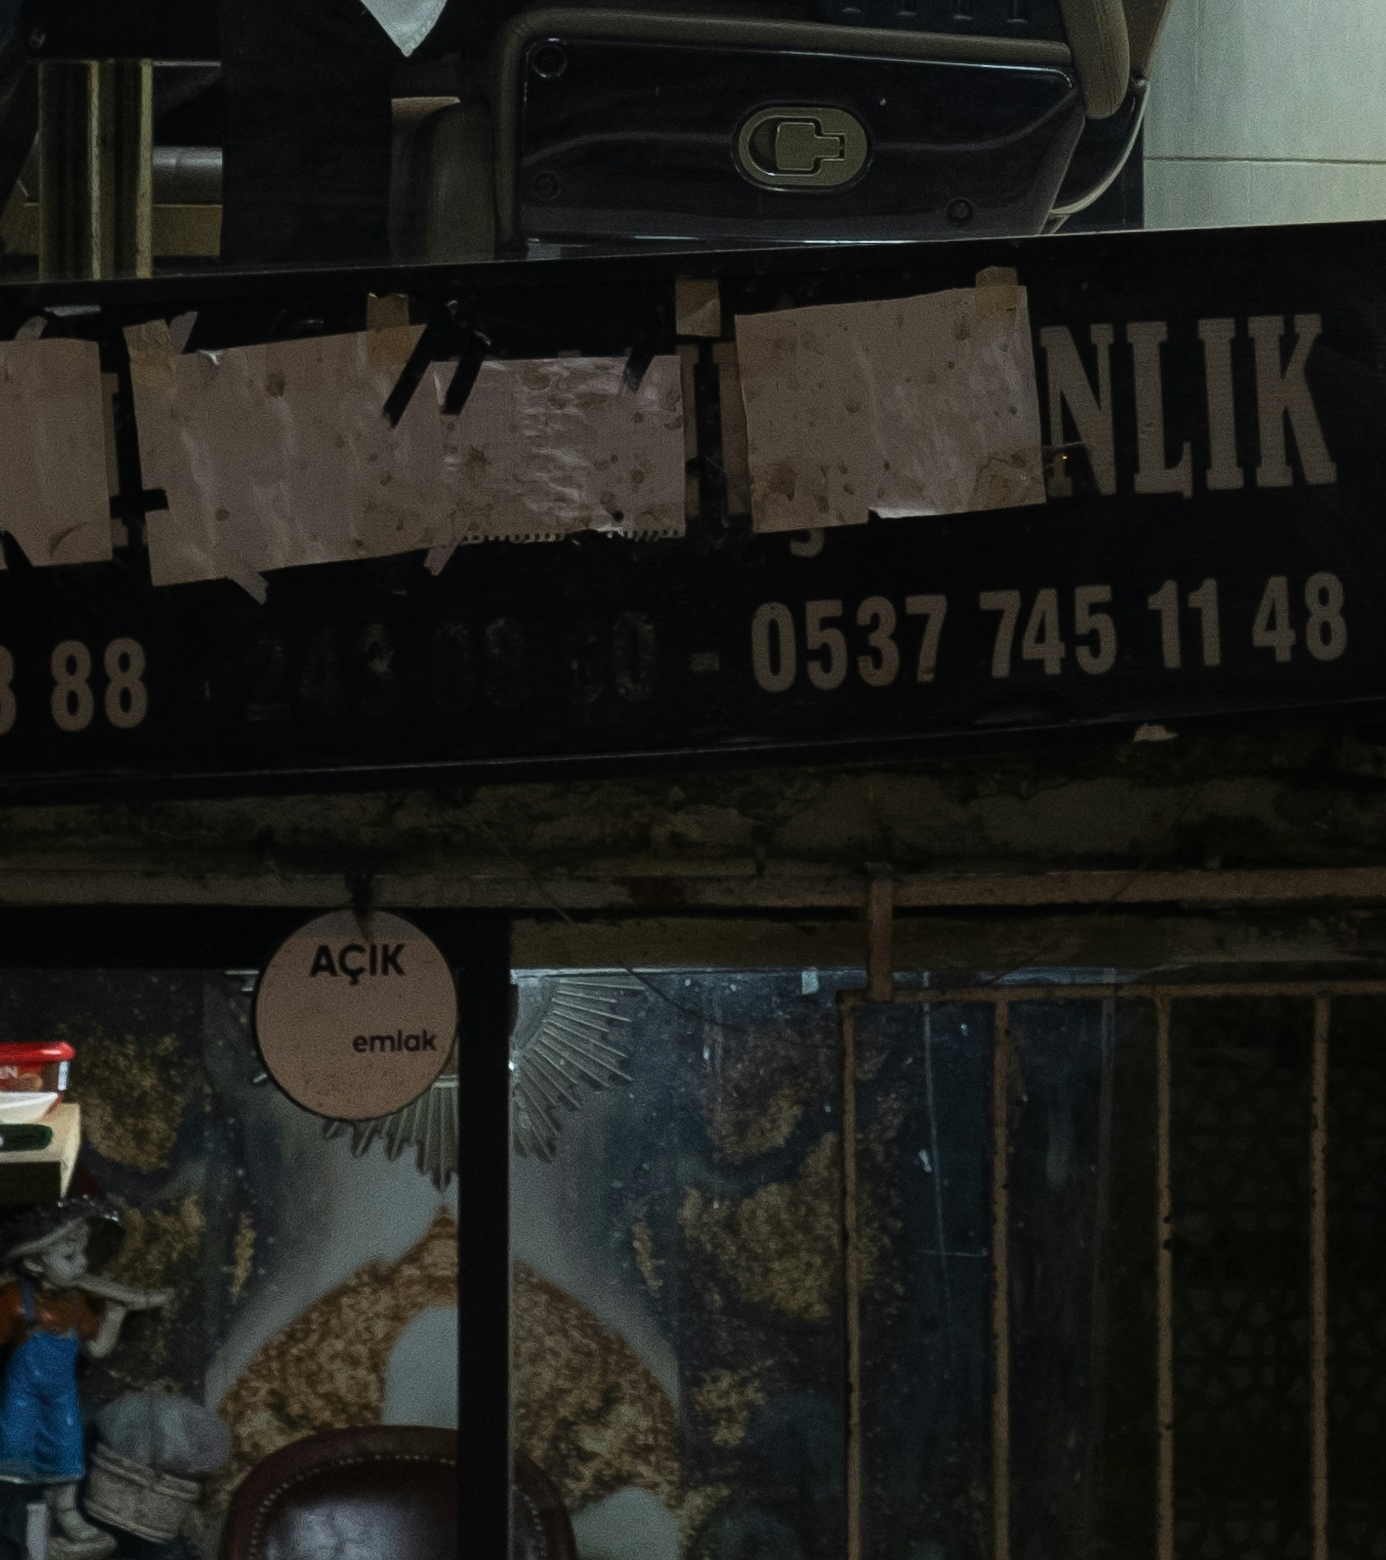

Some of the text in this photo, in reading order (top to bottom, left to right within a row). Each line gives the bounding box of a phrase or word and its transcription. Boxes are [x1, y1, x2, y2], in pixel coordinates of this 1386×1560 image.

[50, 636, 150, 733] 88
[751, 593, 949, 694] 0537
[978, 583, 1119, 681] 745
[1145, 576, 1223, 670] 11
[1250, 570, 1351, 666] 48
[308, 943, 406, 987] AÇIK
[351, 1029, 439, 1053] emlak
